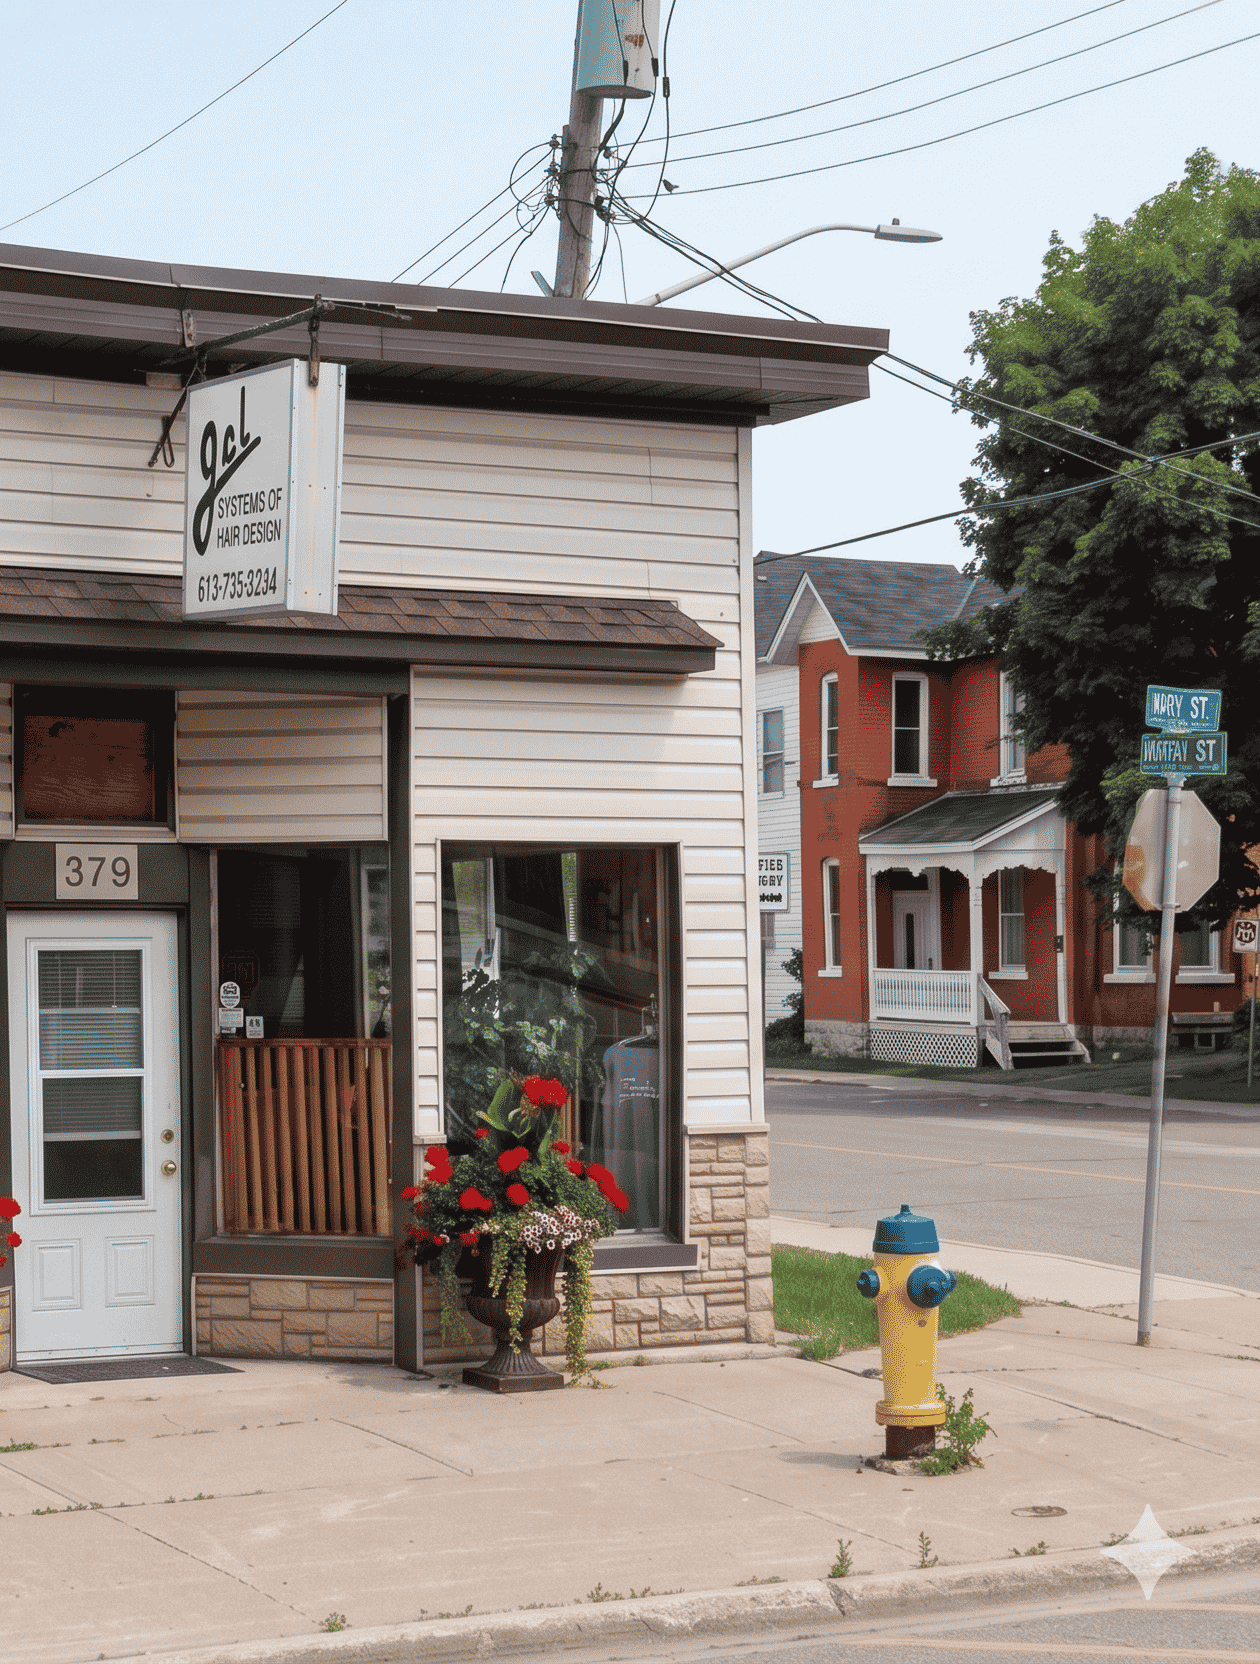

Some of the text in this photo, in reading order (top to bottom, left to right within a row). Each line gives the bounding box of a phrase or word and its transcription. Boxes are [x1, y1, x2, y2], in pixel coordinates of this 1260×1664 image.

[218, 488, 282, 519] SYSTEMS OF
[217, 519, 281, 549] HAIR DESIGN
[1195, 739, 1216, 761] ST
[65, 856, 131, 887] 379
